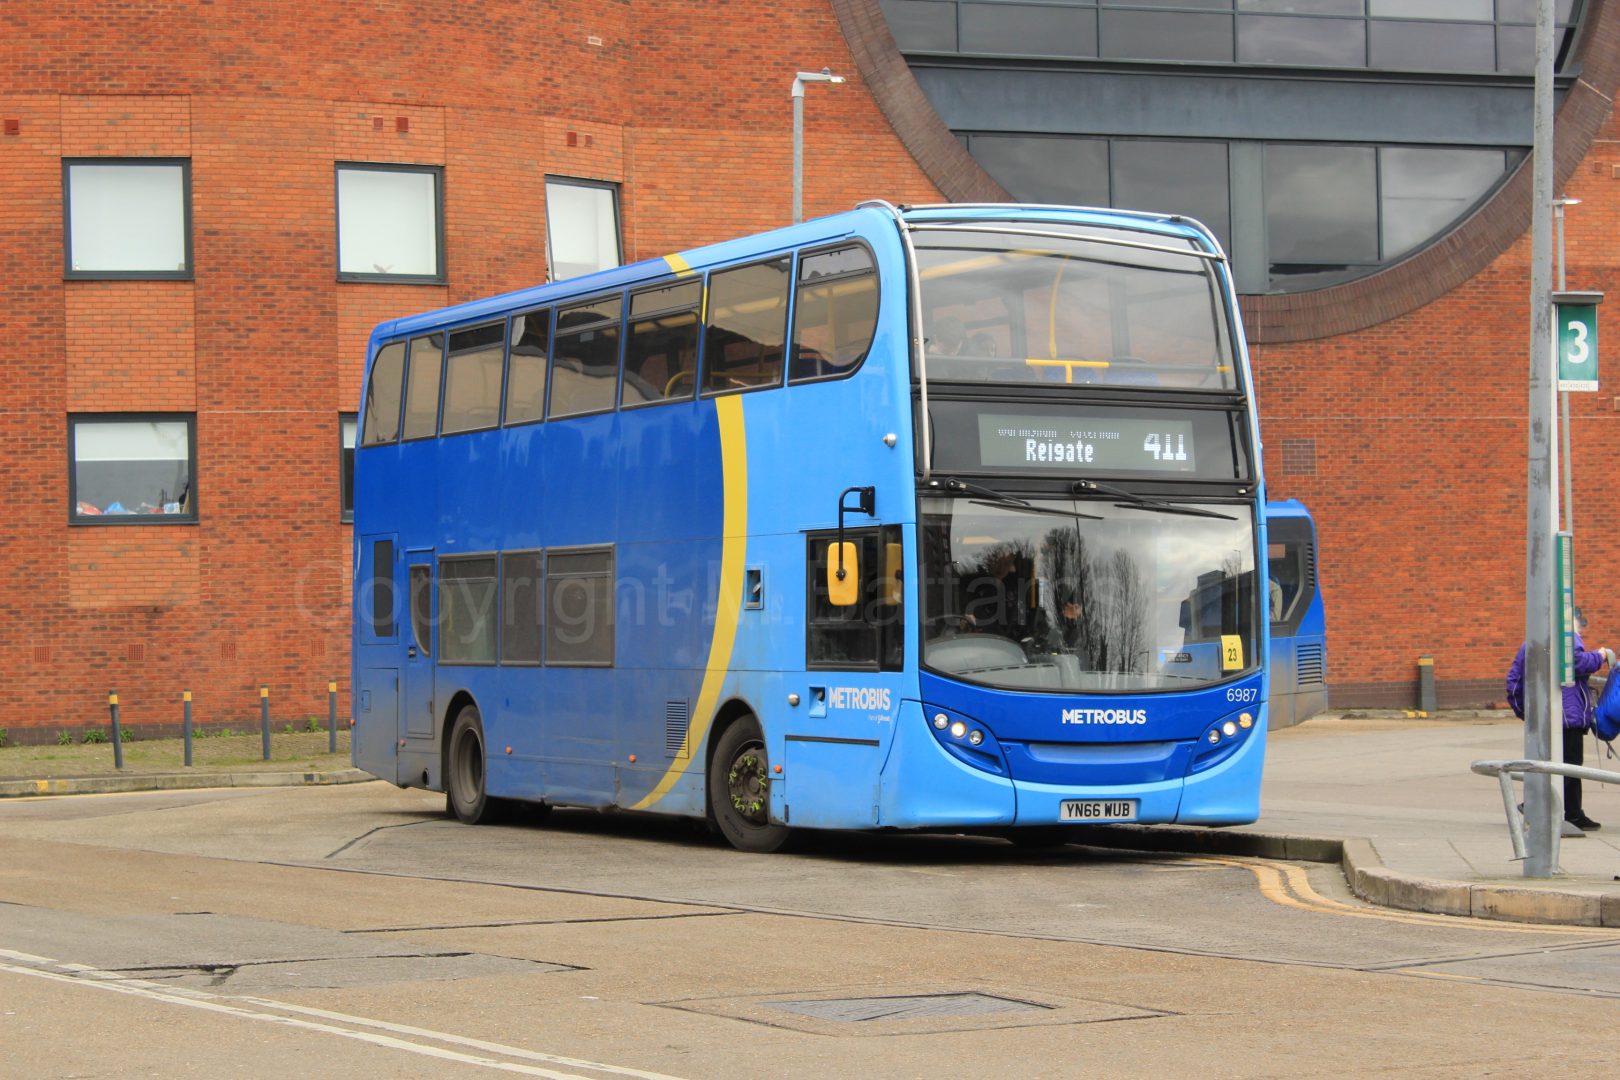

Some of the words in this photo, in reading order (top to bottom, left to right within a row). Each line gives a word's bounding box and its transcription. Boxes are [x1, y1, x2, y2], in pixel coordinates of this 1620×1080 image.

[1567, 320, 1589, 364] 3
[1025, 438, 1094, 462] Reigate
[1143, 433, 1187, 460] 411
[1227, 648, 1238, 662] 23
[829, 687, 891, 711] METROBUS
[1226, 688, 1258, 702] 6987
[1061, 709, 1147, 725] METROBUS
[1066, 803, 1101, 817] YN66
[1104, 803, 1131, 817] WUB
